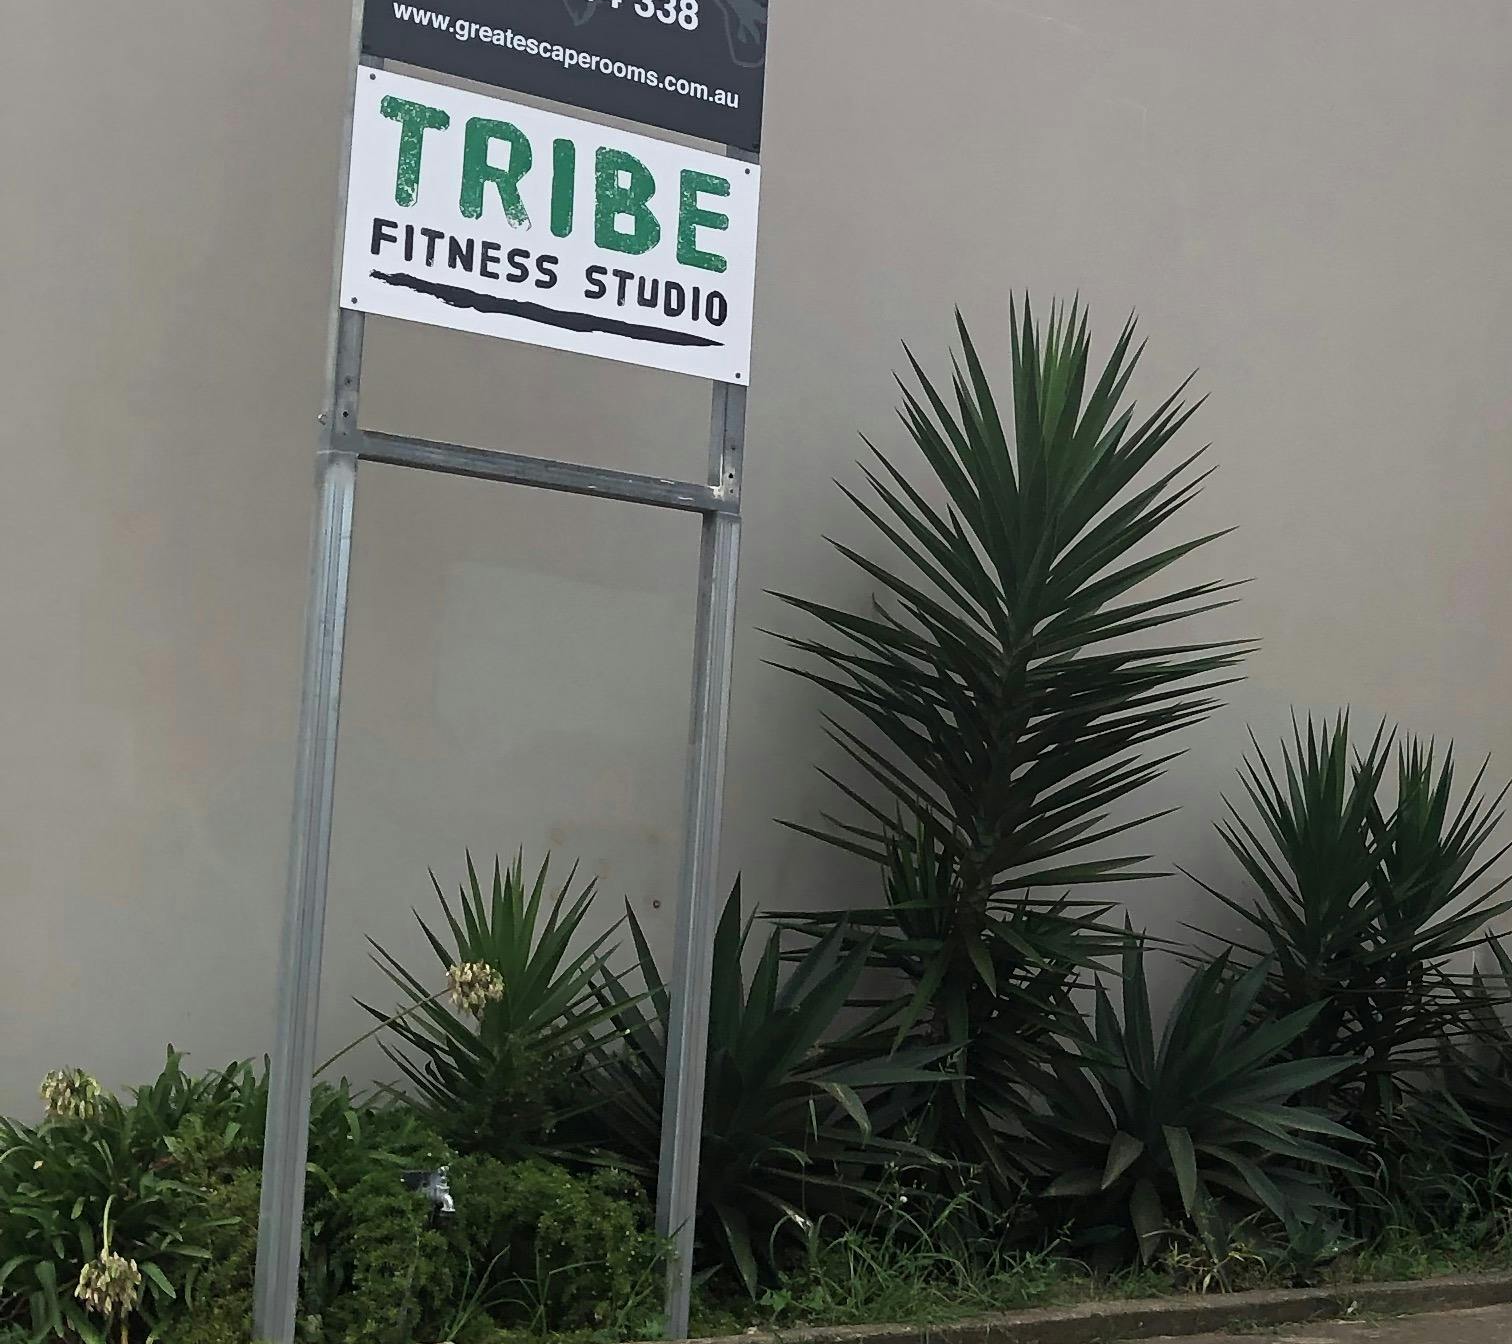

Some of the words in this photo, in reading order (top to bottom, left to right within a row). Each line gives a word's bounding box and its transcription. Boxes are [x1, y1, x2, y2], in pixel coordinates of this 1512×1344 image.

[393, 0, 739, 109] www.greatescaperooms.com.au
[380, 93, 731, 274] TRIBE
[370, 217, 558, 289] FITNESS
[584, 264, 728, 326] STUDIO
